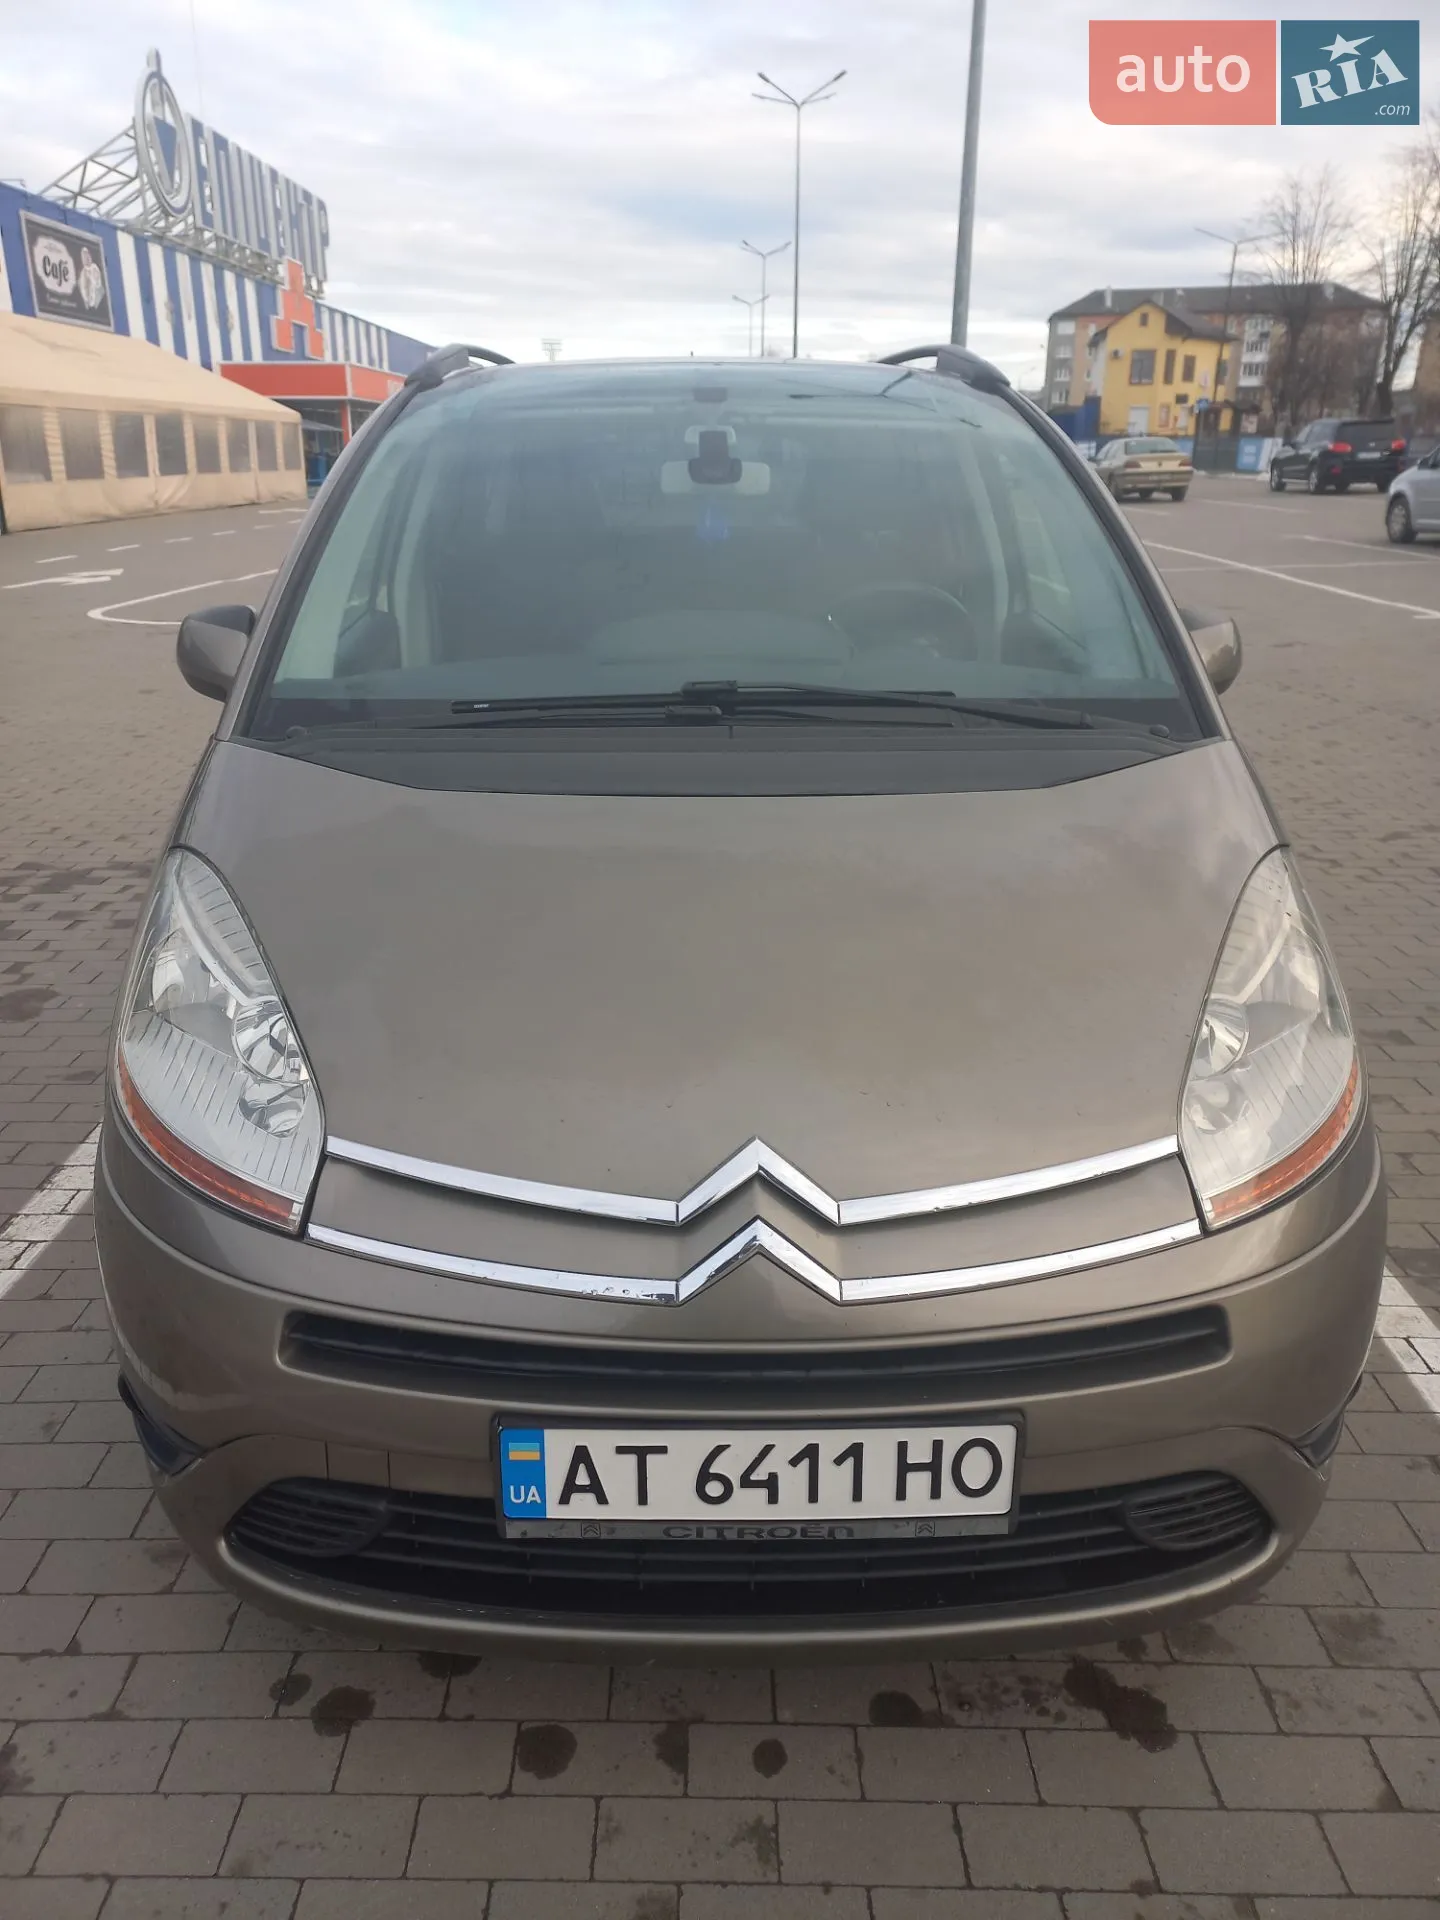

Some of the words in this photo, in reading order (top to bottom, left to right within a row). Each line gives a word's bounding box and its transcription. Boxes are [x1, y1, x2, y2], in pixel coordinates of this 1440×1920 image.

[42, 255, 70, 287] Café
[558, 1445, 668, 1505] AT
[695, 1442, 864, 1505] 6411
[895, 1437, 1003, 1502] HO
[509, 1485, 542, 1504] UA
